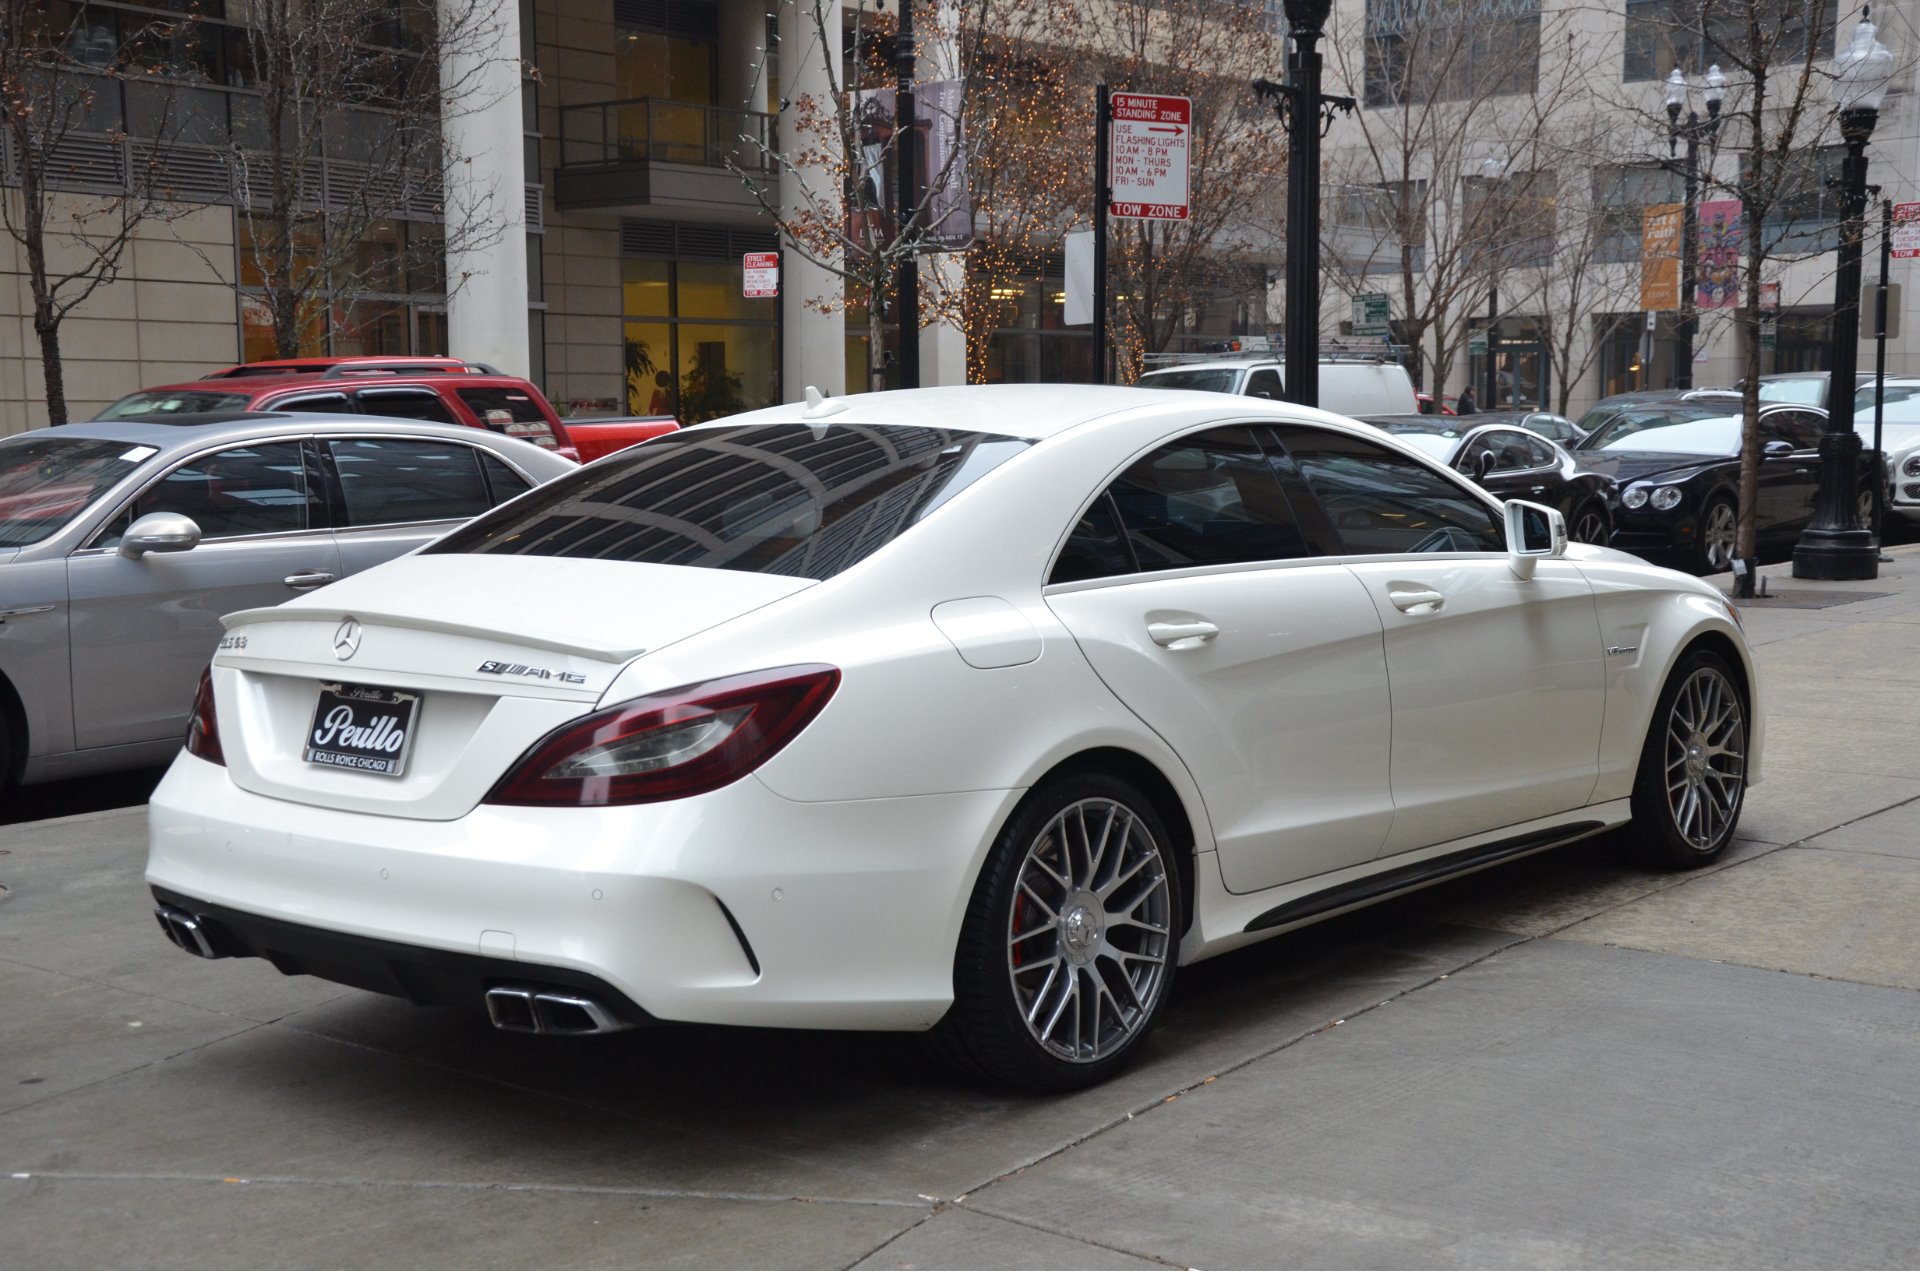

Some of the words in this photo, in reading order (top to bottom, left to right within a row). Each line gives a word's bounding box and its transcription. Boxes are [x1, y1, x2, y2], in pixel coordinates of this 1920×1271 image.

[1117, 97, 1125, 107] 15
[1128, 98, 1158, 109] MINUTE
[1116, 108, 1156, 119] STANDING
[1160, 111, 1182, 121] ZONE
[1116, 125, 1132, 134] USE
[1116, 135, 1156, 146] FLASHING
[1158, 138, 1185, 148] LIGHTS
[1147, 147, 1153, 156] 8
[1155, 148, 1168, 157] PM
[1115, 156, 1134, 165] MON
[1144, 157, 1171, 167] THURS
[1147, 168, 1152, 176] 6
[1154, 168, 1167, 177] PM
[1115, 177, 1129, 185] FRI
[1136, 178, 1155, 187] SUN
[1115, 203, 1142, 215] TOW
[1148, 205, 1182, 218] ZONE
[1894, 250, 1914, 258] TOW
[522, 667, 587, 684] AMG
[349, 687, 383, 699] Perillo
[314, 705, 404, 753] Perillo
[315, 751, 335, 764] ROLLS
[335, 753, 357, 767] ROYCE
[357, 756, 386, 771] CHICAGO
